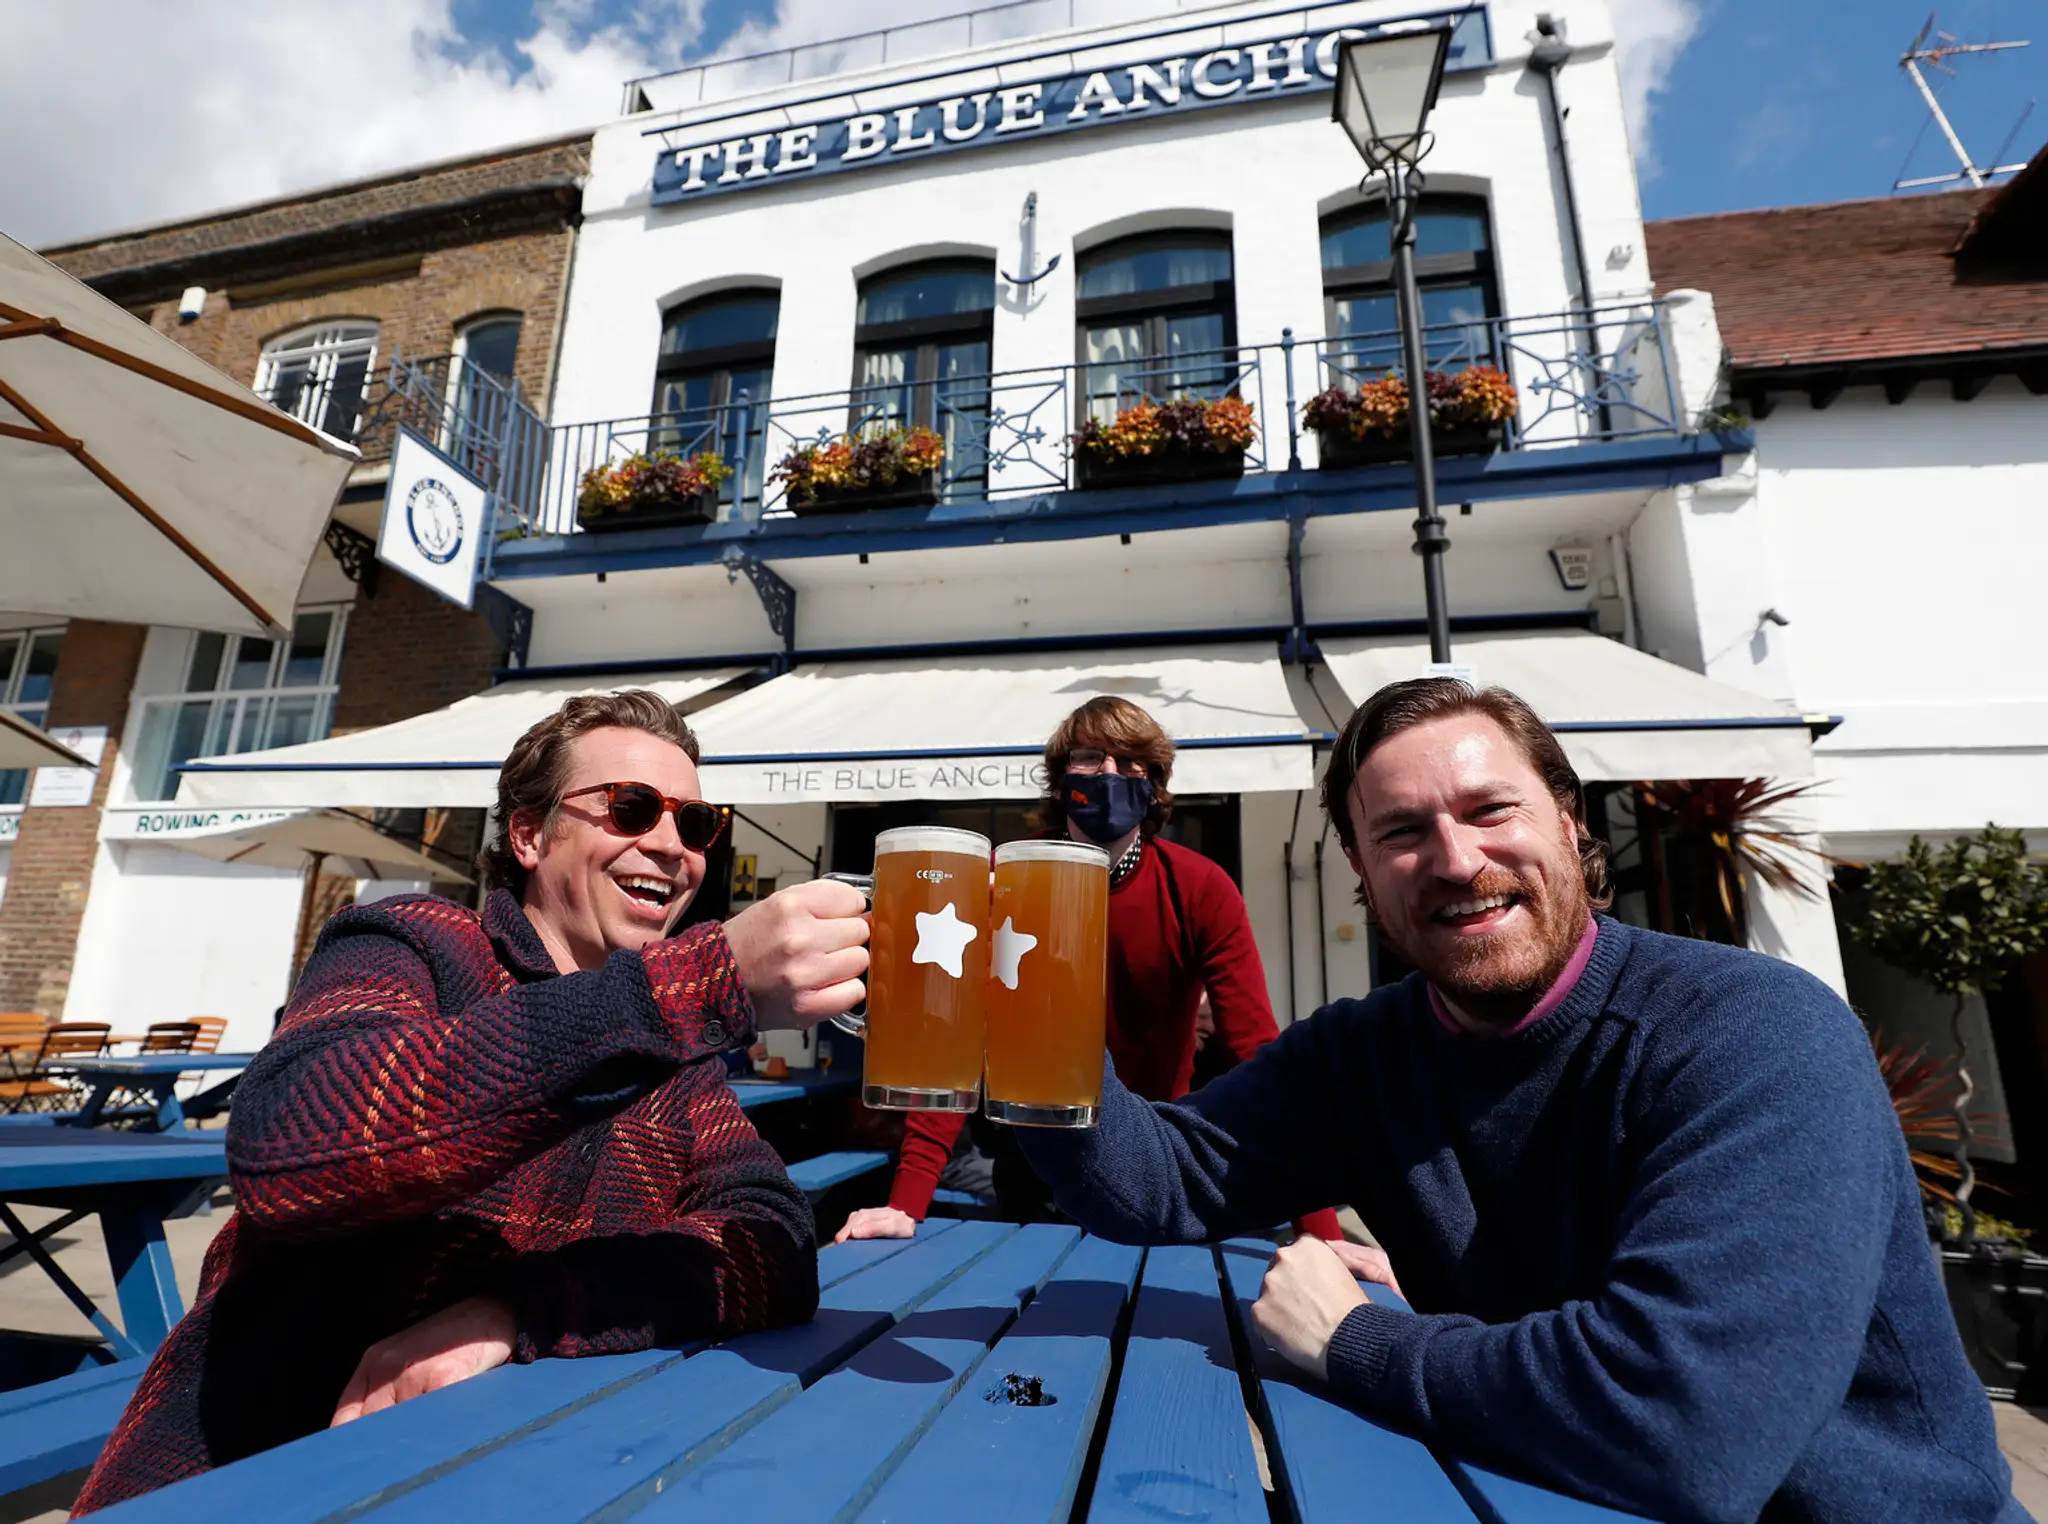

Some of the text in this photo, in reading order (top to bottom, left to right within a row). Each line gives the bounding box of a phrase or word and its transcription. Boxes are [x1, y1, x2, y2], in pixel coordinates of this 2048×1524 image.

[676, 19, 1431, 192] THE BLUE ANCHO
[762, 763, 1051, 792] THE BLUE ANCHO
